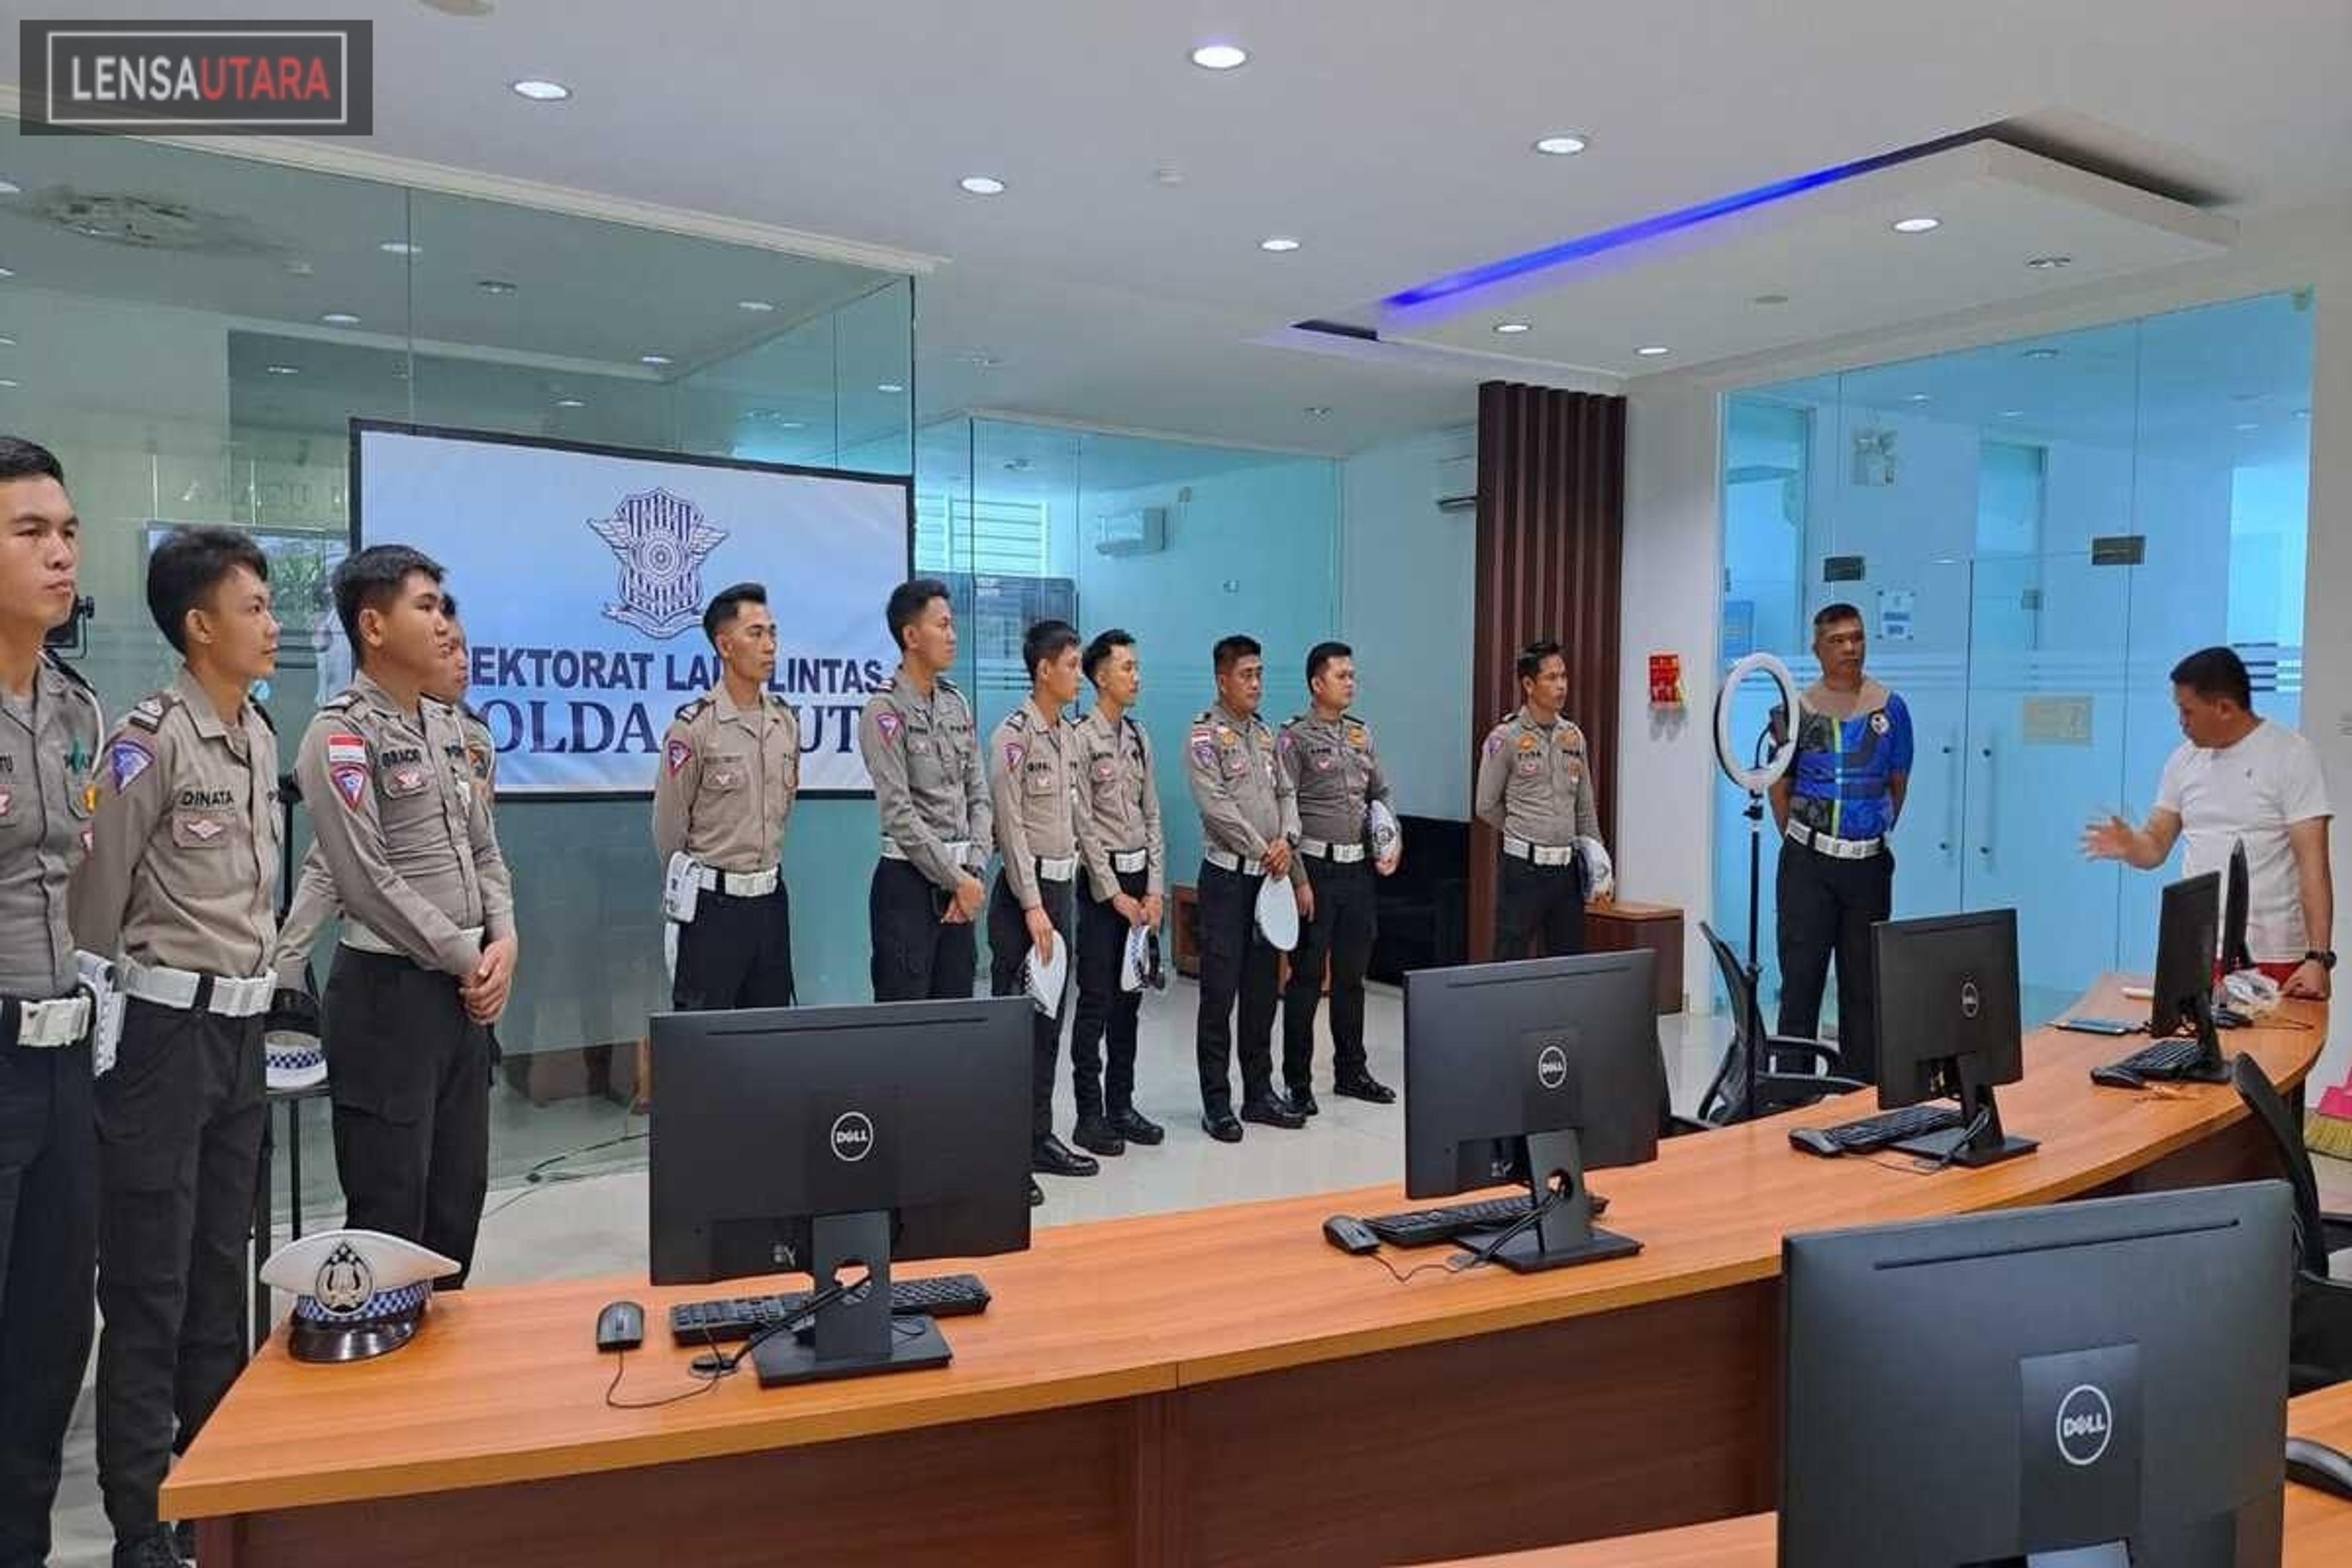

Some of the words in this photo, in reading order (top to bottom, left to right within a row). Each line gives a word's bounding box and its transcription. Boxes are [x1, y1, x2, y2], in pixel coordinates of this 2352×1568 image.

[471, 647, 654, 691] EKTORAT
[768, 658, 882, 694] LINTAS
[478, 699, 663, 754] OLDA
[789, 705, 864, 753] UT
[181, 790, 235, 807] DINATA
[837, 1129, 869, 1144] DELL
[2064, 1412, 2106, 1438] DELL
